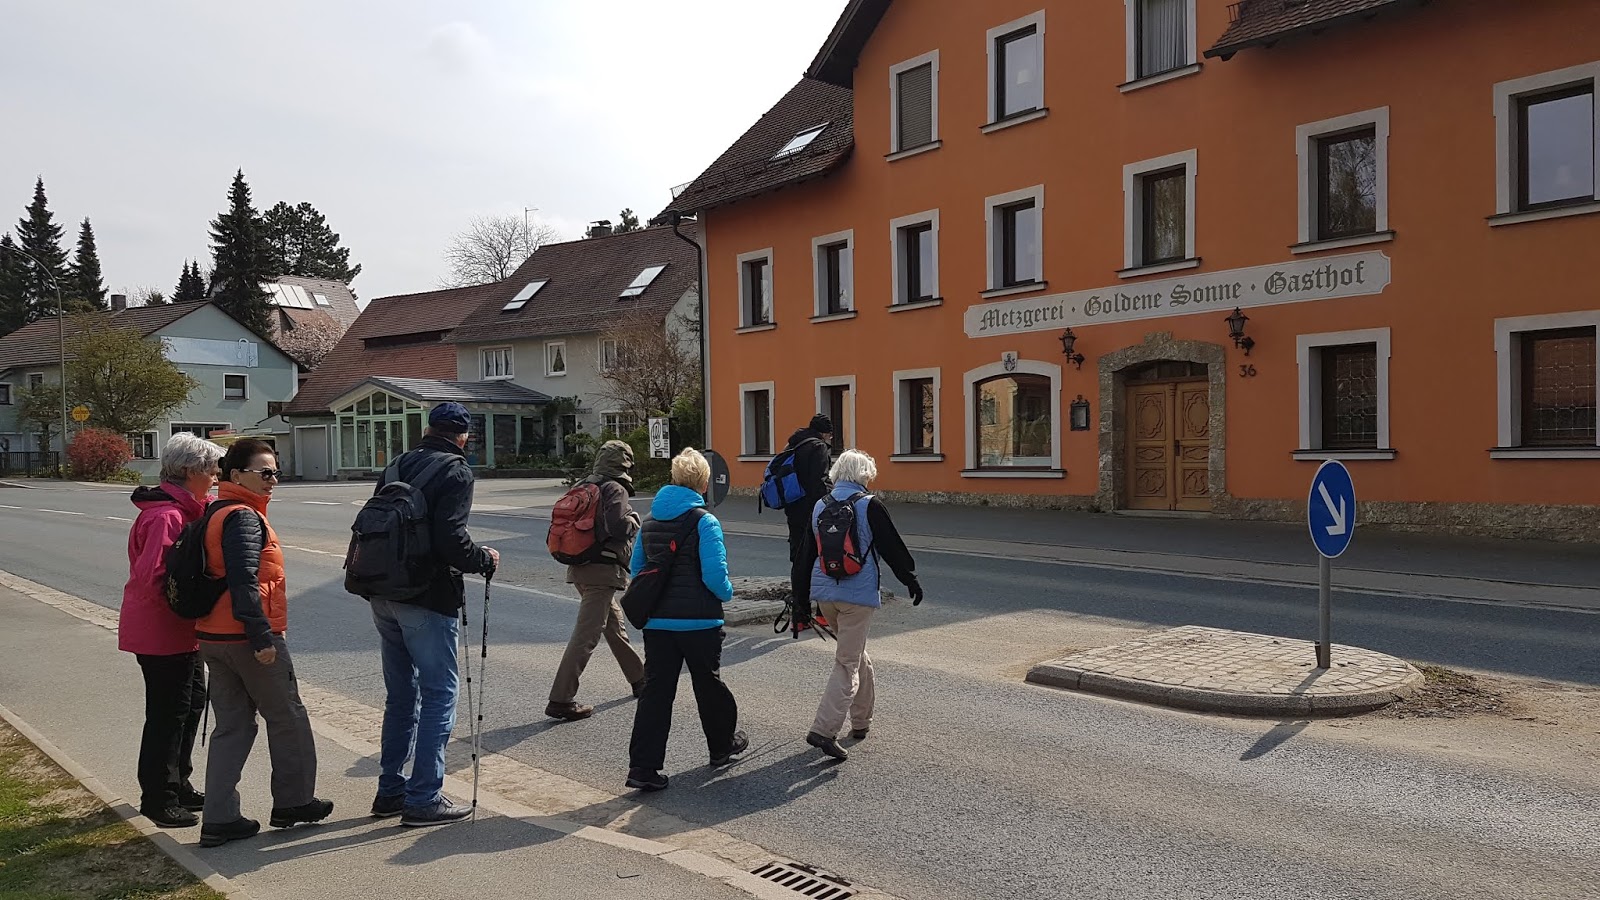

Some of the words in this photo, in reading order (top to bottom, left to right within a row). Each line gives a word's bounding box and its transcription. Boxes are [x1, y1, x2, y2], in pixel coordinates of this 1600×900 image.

[979, 300, 1064, 331] Metzgerei
[1083, 291, 1162, 316] Goldene
[1169, 280, 1241, 307] Sonne
[1264, 260, 1365, 295] Gasthof
[1239, 364, 1257, 378] 36
